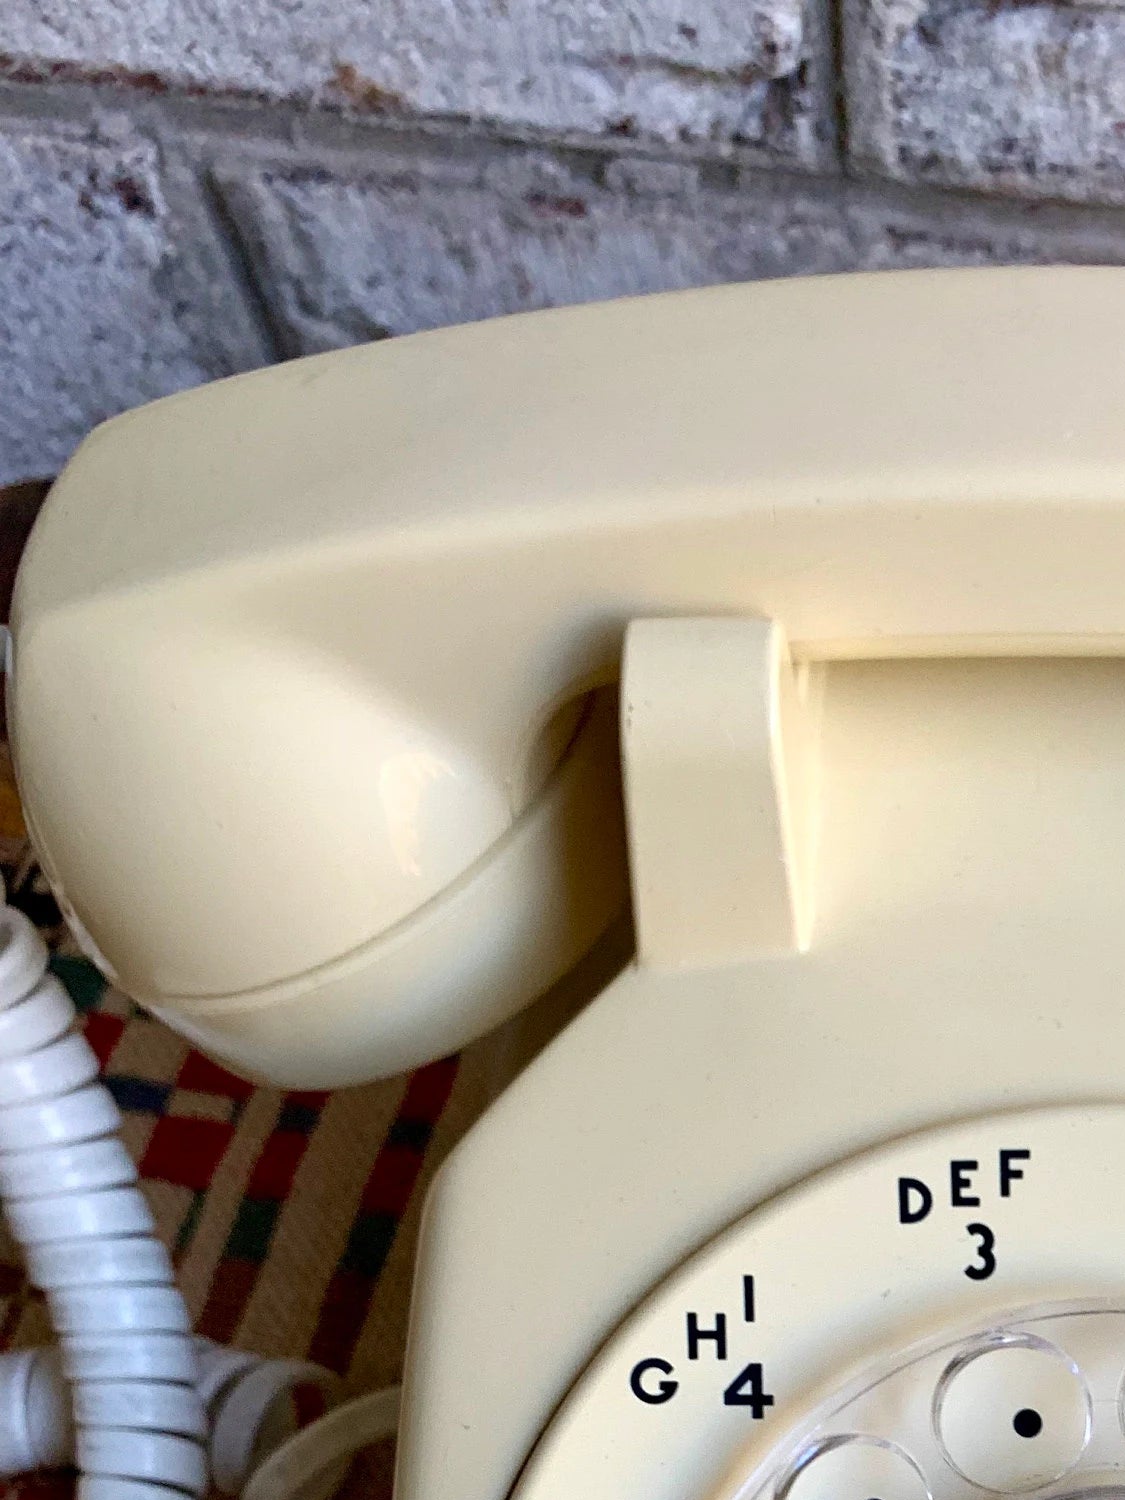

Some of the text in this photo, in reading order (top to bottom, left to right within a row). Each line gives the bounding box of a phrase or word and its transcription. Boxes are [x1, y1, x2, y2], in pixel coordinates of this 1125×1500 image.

[898, 1149, 1031, 1224] DEF
[964, 1222, 996, 1281] 3
[723, 1362, 775, 1420] 4
